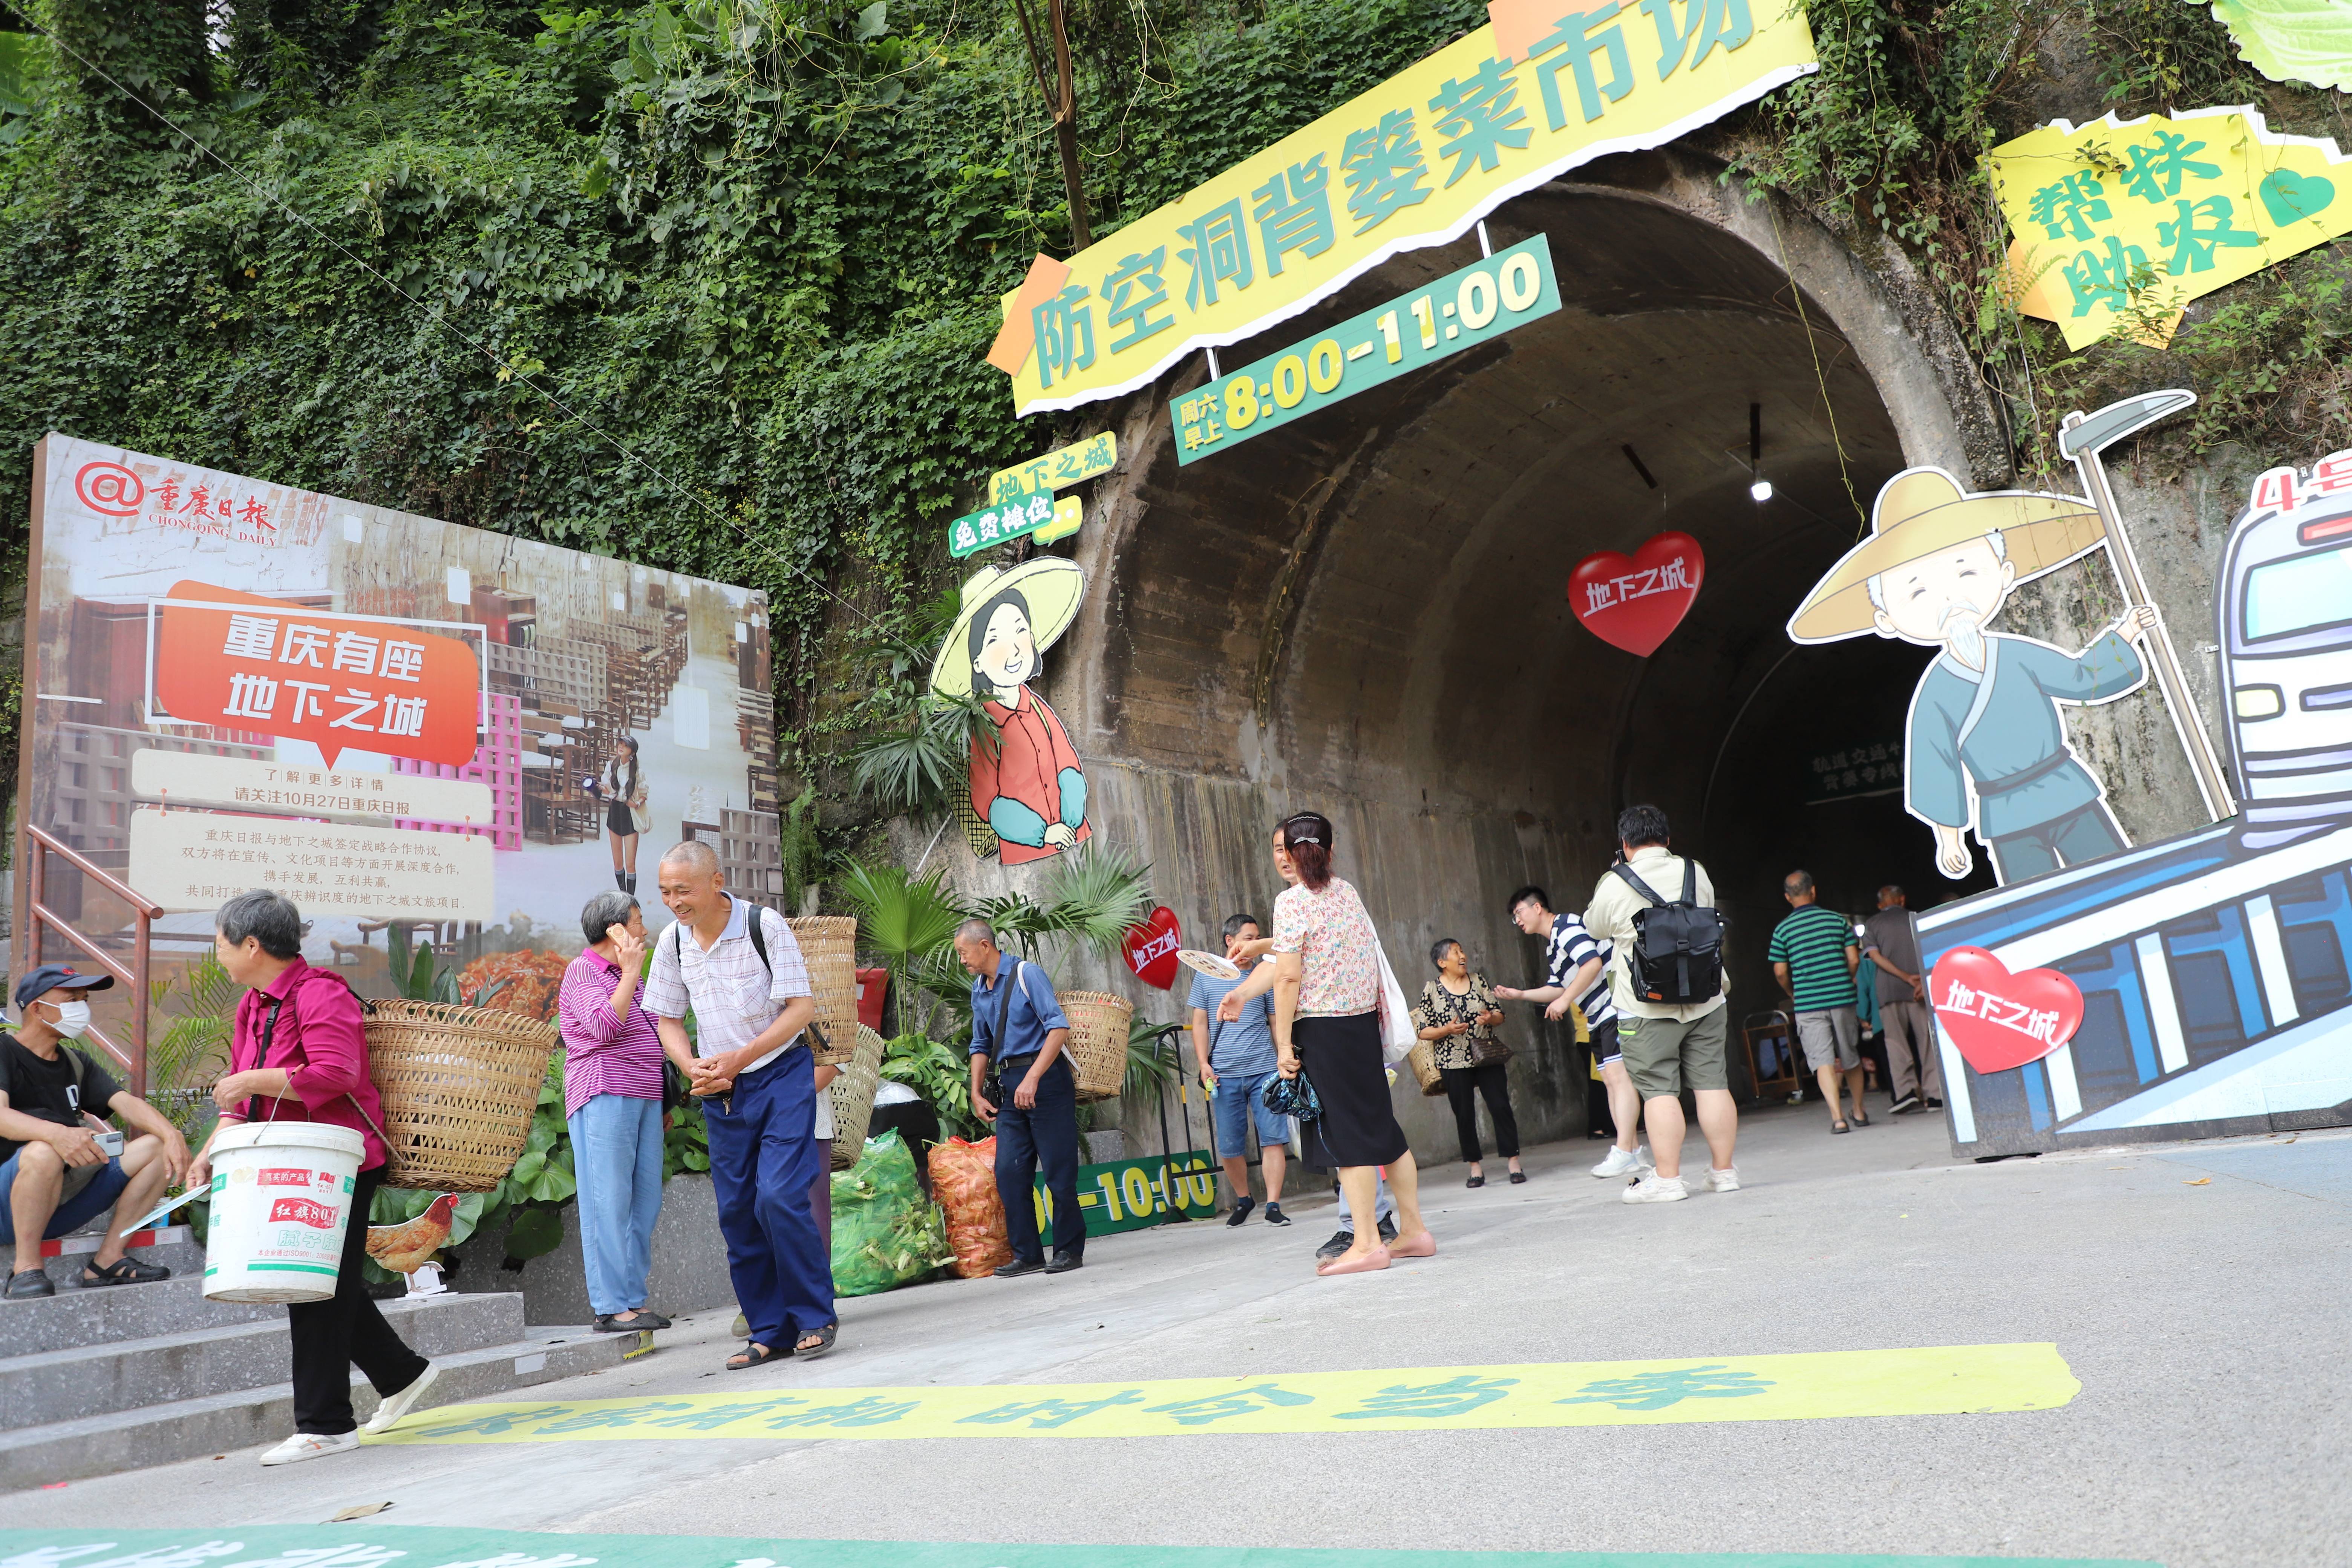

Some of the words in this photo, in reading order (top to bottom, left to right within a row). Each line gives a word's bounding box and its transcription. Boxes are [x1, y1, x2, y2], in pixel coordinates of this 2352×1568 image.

[1224, 251, 1541, 431] 8:00-11:00
[1180, 393, 1220, 427] 周六
[1184, 419, 1224, 451] 早上
[996, 437, 1113, 504] 地下之城
[148, 514, 230, 538] CHONGQING
[239, 531, 277, 547] DAILY
[955, 496, 1052, 551] 免费摊位
[1583, 556, 1695, 618] 地下之城
[223, 614, 425, 683] 重庆有座
[222, 672, 427, 738] 地下之城
[234, 786, 410, 815] 请关注10月27日重庆日报
[1132, 927, 1182, 974] 地下之城
[1936, 979, 2060, 1050] 地下之城
[266, 1172, 305, 1182] 真实的产品
